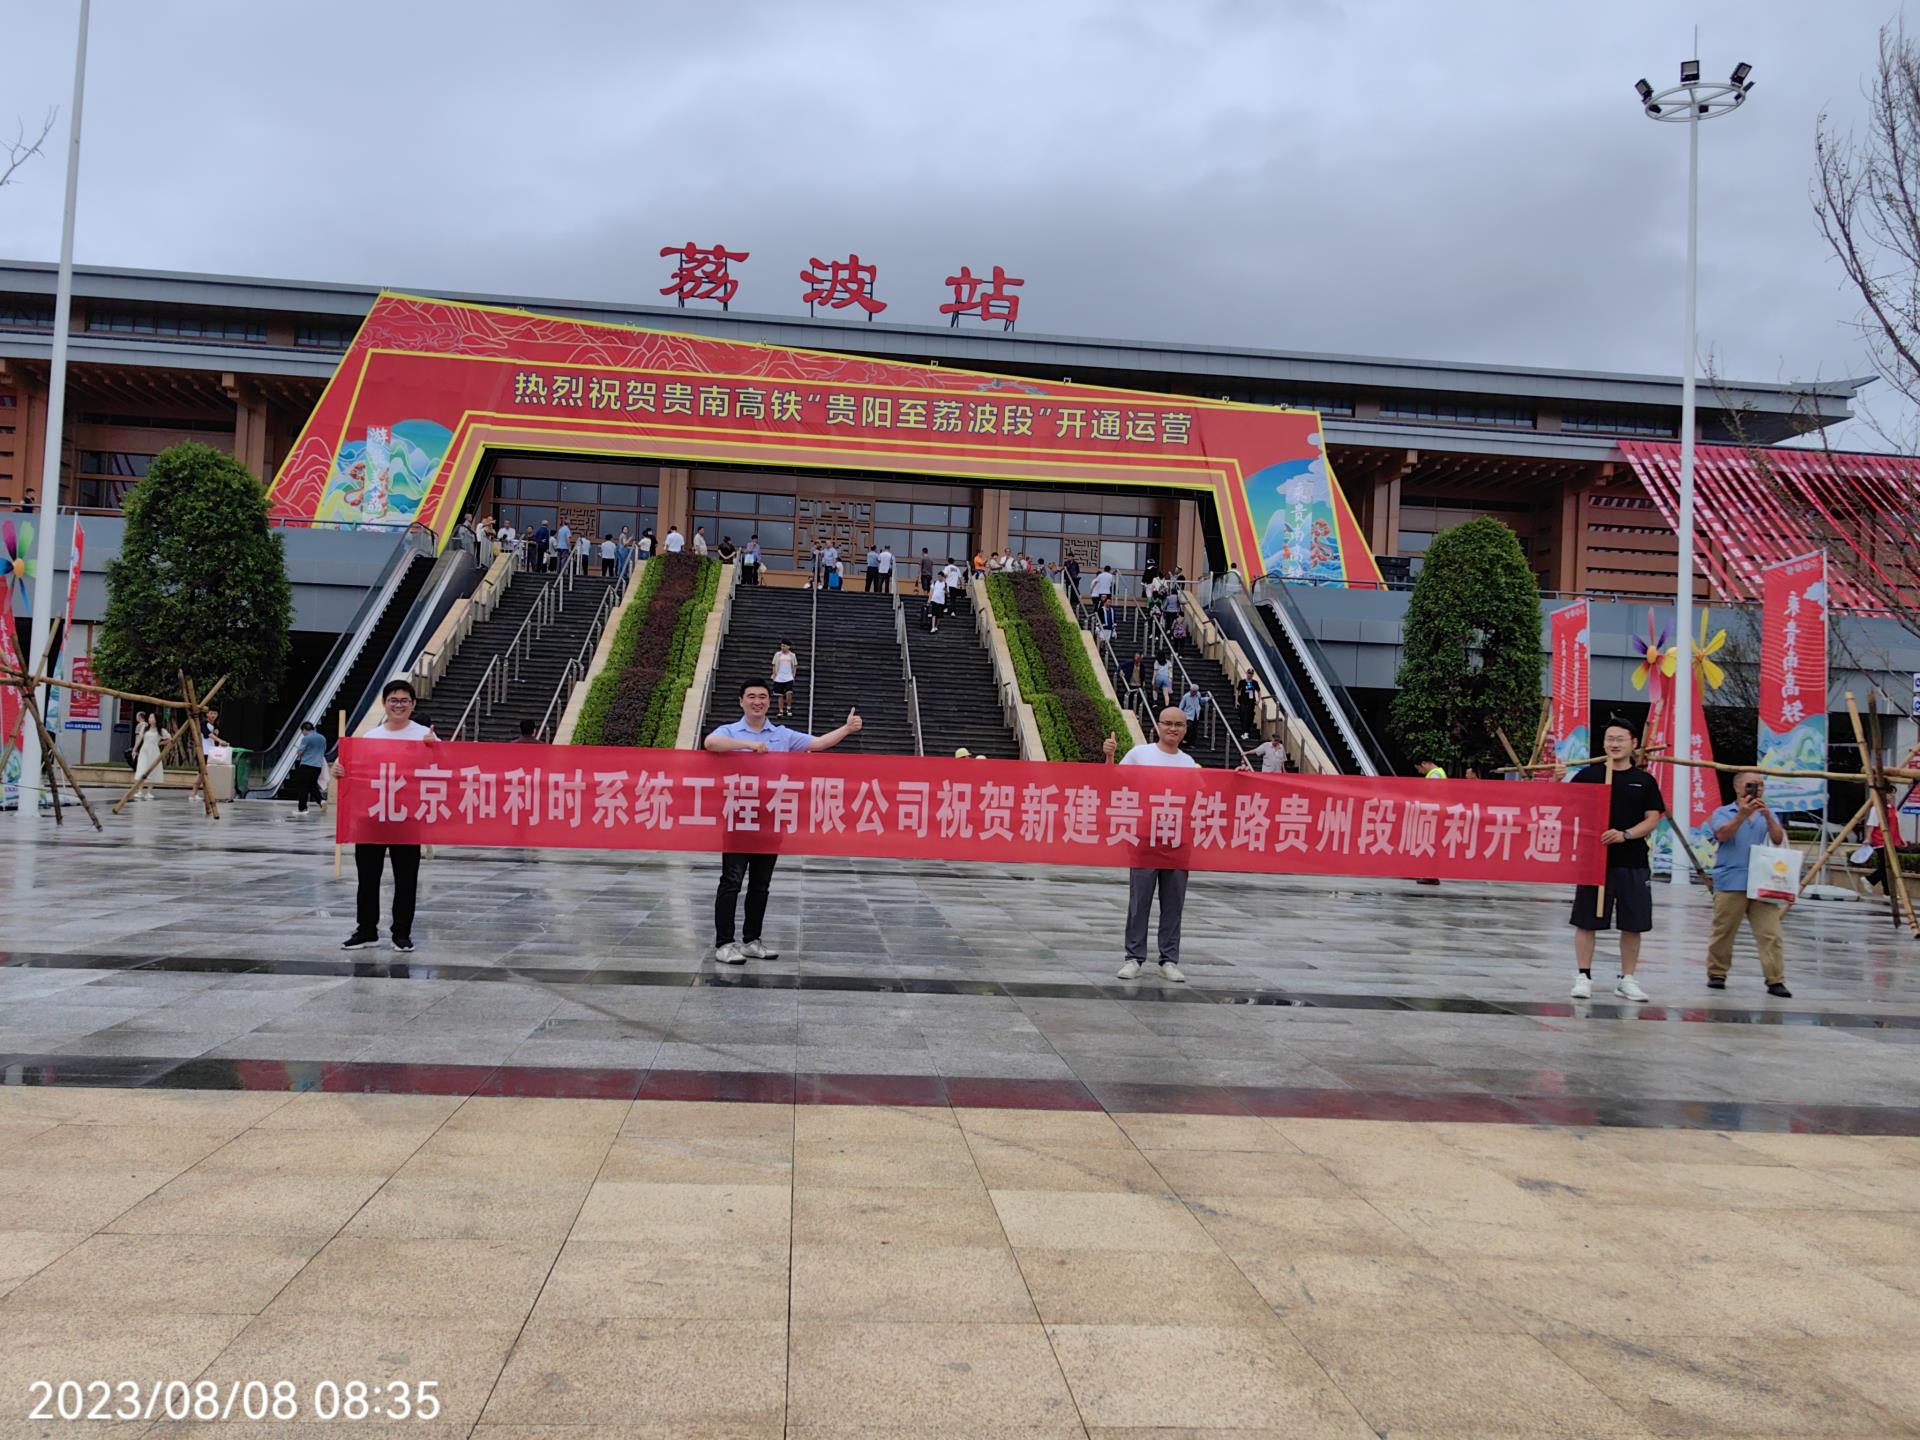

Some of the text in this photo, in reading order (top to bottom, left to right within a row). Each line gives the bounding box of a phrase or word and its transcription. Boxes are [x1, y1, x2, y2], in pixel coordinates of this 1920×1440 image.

[660, 241, 1025, 322] 荔波站
[514, 371, 1192, 445] 热烈祝贺贵南高铁“贵阳至荔波段”开通运营
[368, 761, 1580, 863] 北京和利时系统工程有限公司祝贺新建贵南铁路贵州段顺利开通!
